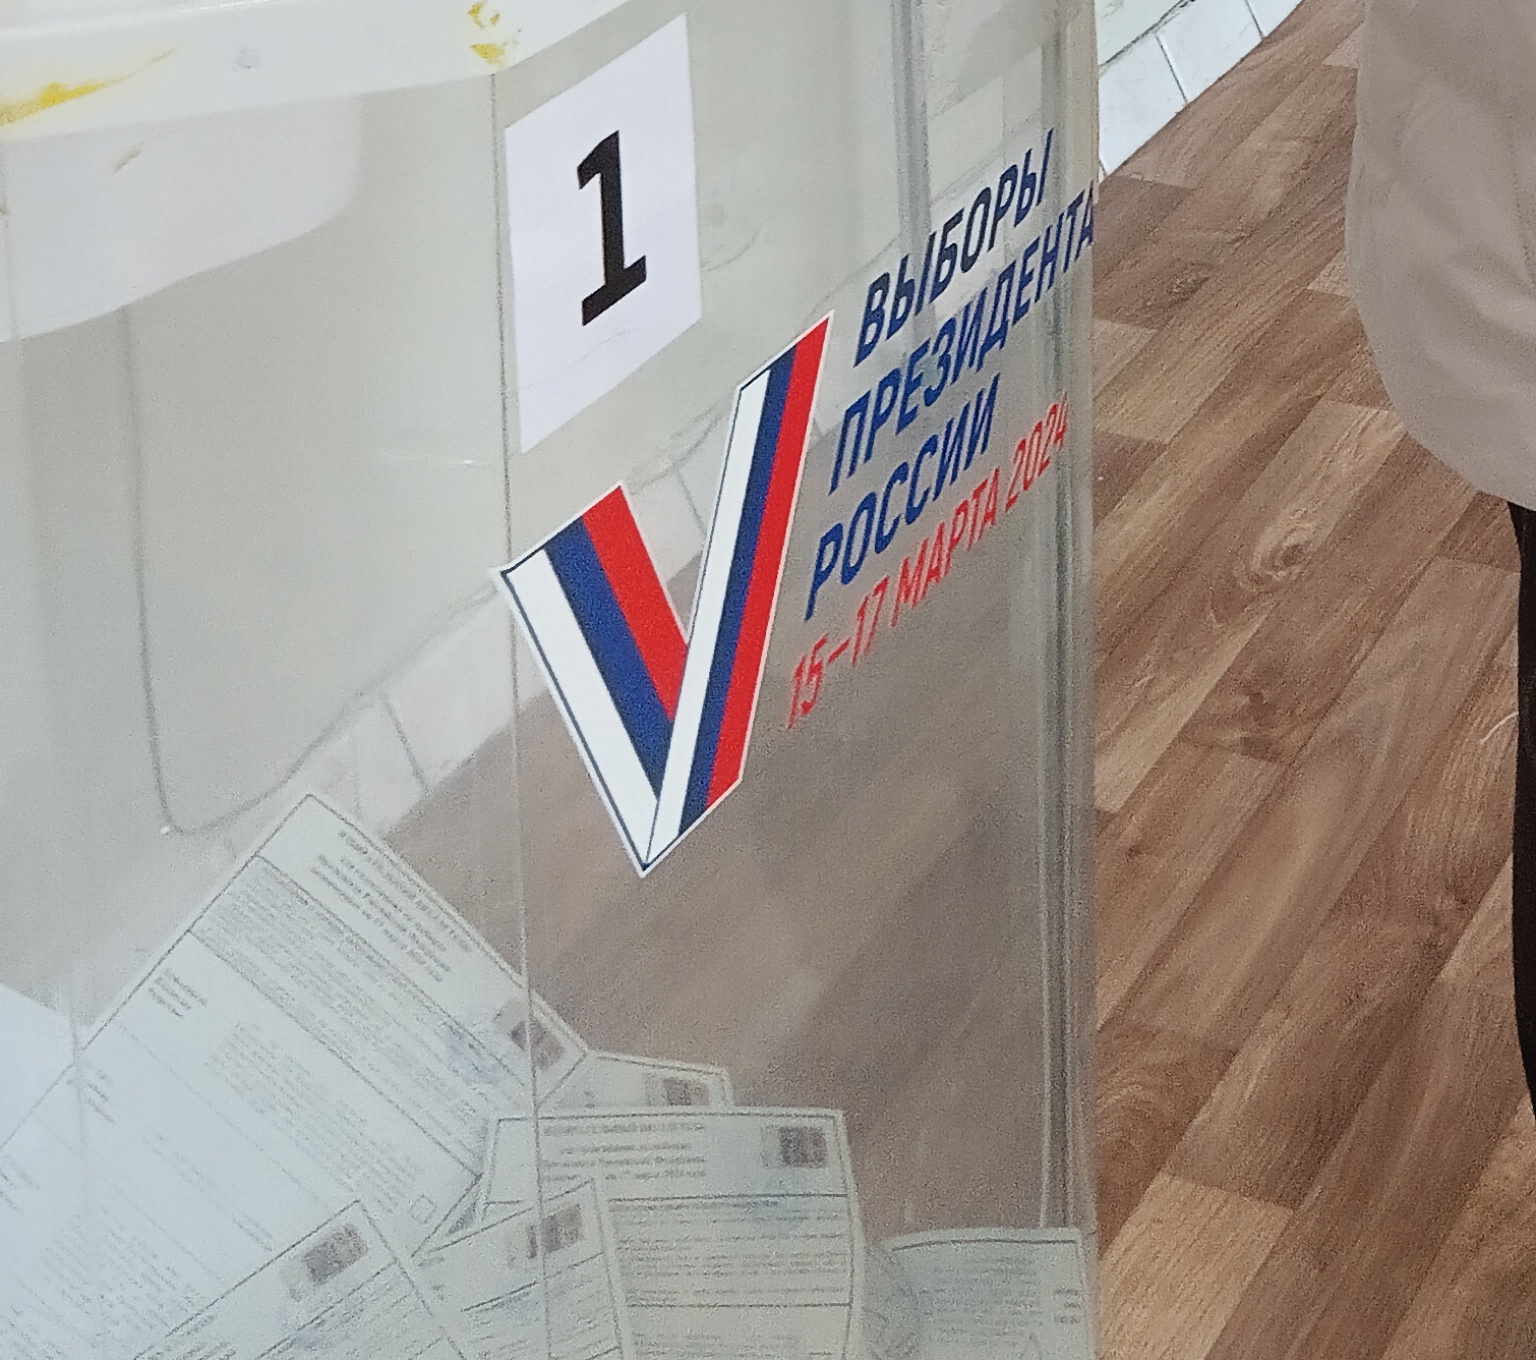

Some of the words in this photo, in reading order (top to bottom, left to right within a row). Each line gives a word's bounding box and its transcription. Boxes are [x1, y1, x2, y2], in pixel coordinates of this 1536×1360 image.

[577, 129, 648, 327] 1
[828, 180, 1094, 496] ПРЕЗИДЕНТА
[853, 128, 1054, 368] ВЫБОРЫ
[804, 372, 1001, 623] РОССИИ
[891, 465, 1000, 628] МАРТА
[1004, 390, 1069, 514] 2024
